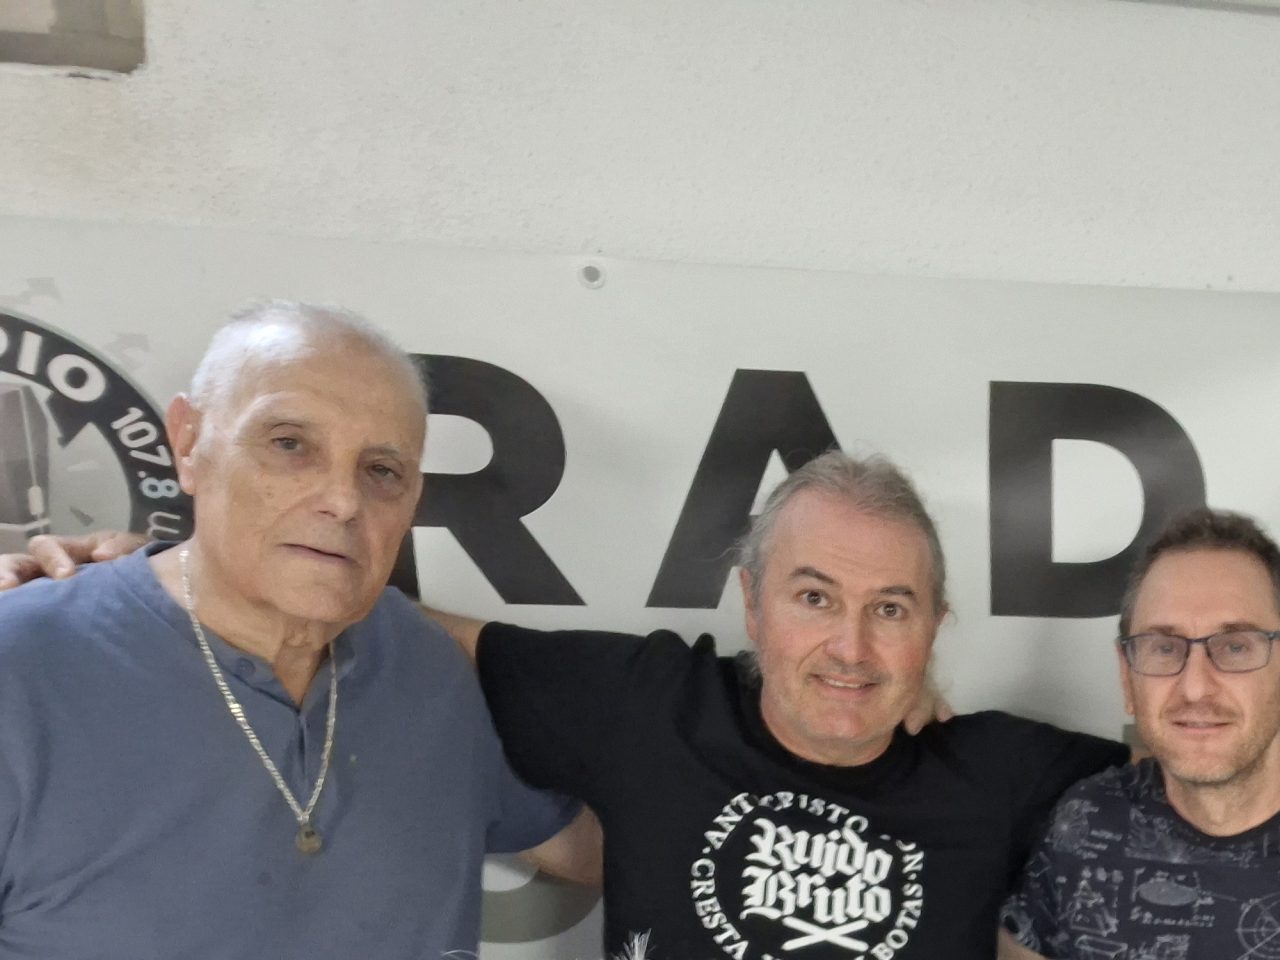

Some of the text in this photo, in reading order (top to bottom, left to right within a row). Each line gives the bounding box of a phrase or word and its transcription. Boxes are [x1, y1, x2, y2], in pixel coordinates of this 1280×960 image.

[110, 406, 180, 498] 107.8
[745, 818, 893, 885] Ruido
[690, 858, 749, 960] CRESTA
[739, 866, 892, 924] Bruto
